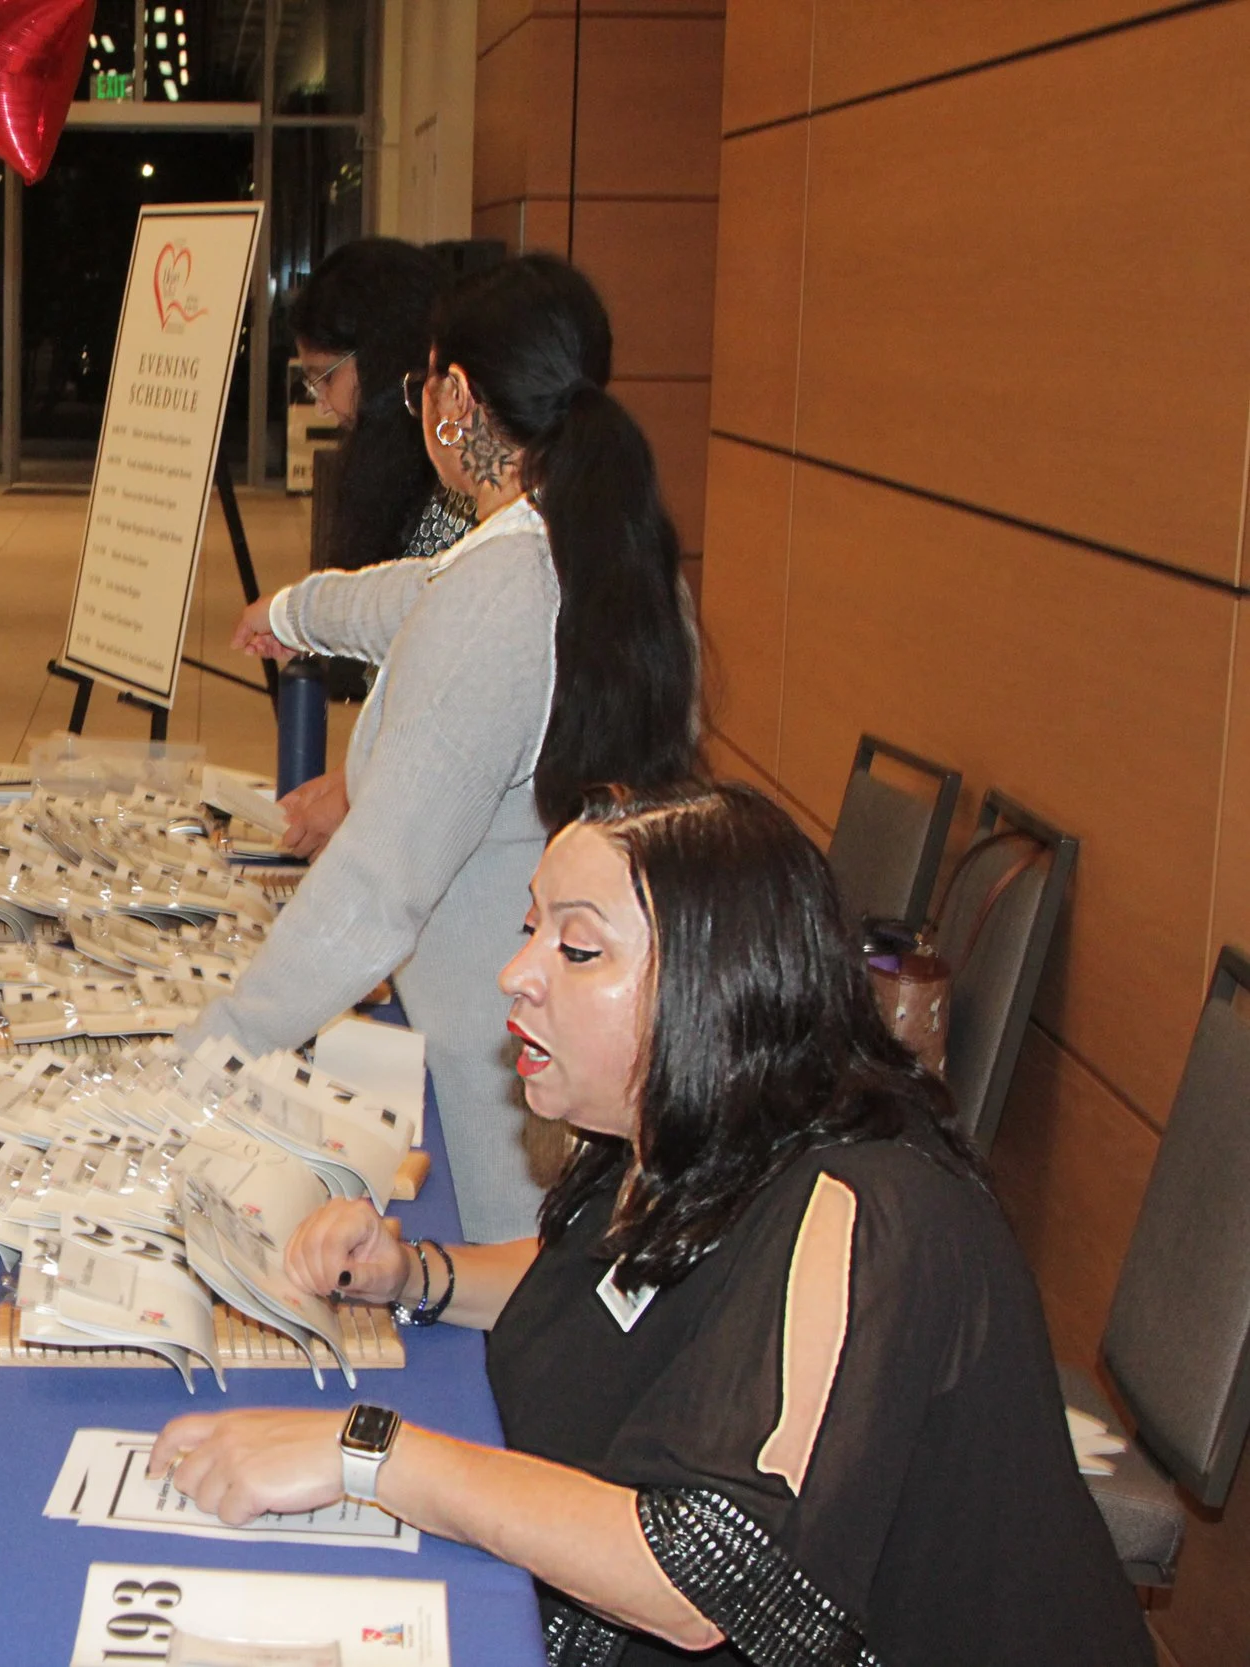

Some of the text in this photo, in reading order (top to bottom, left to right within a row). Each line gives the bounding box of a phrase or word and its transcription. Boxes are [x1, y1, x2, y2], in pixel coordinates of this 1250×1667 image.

[96, 74, 127, 98] EXIT
[138, 352, 201, 380] EVENING
[128, 383, 199, 413] SCHEDULE
[102, 1579, 183, 1664] 193
